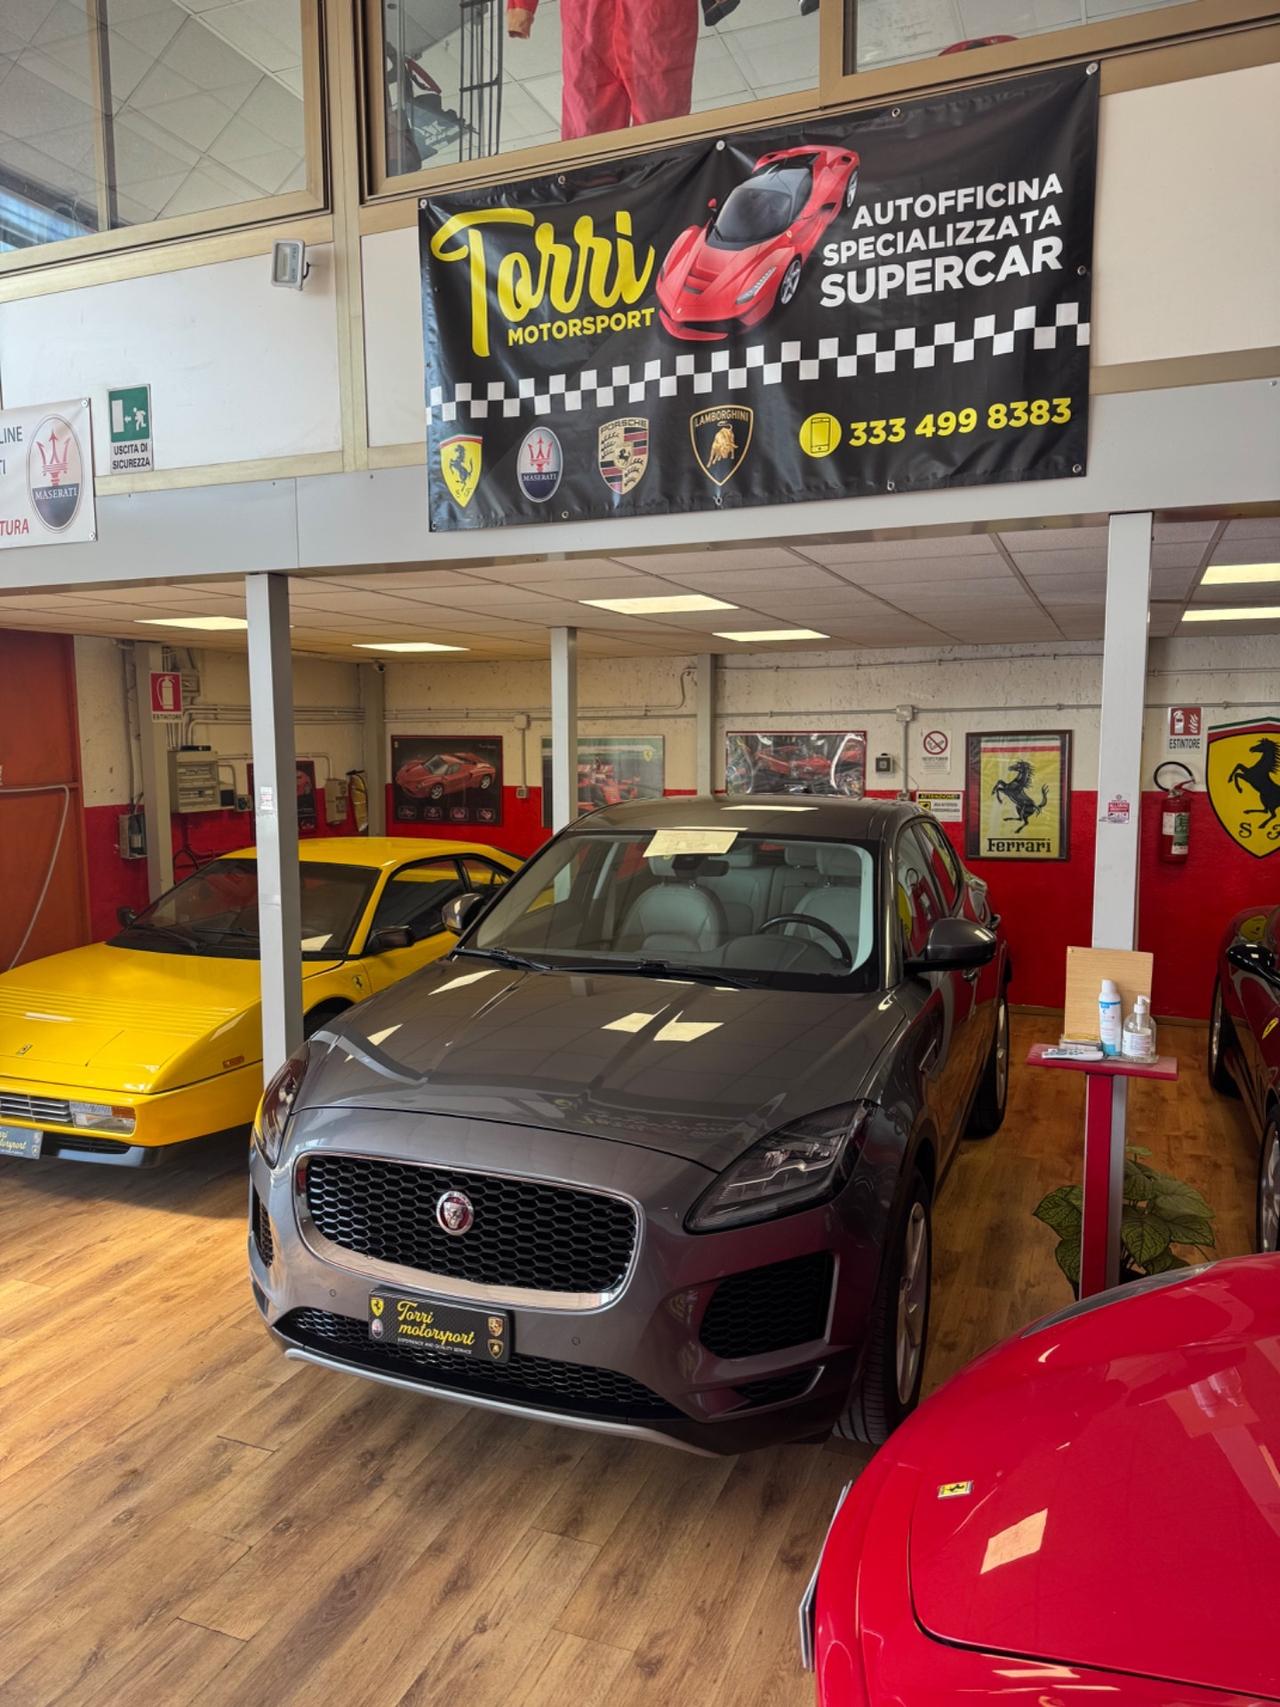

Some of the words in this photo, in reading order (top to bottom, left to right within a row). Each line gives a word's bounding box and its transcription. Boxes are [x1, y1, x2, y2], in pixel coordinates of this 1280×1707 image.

[852, 173, 1063, 230] AUTOFFICINA
[822, 204, 1062, 267] SPECIALIZZATA
[820, 235, 1063, 308] SUPERCAR
[430, 207, 656, 357] Torri
[508, 307, 655, 347] MOTORSPORT
[600, 418, 648, 433] PORSCHE
[694, 409, 750, 427] LAMBORGHINI
[849, 417, 906, 447] 333
[914, 407, 977, 438] 499
[987, 397, 1072, 430] 8383
[113, 445, 139, 456] USCITA
[140, 443, 148, 453] DI
[112, 457, 150, 470] SICUREZZA
[523, 473, 557, 482] MASERATI
[34, 487, 78, 499] MASERATI
[1169, 738, 1201, 750] ESTINTORE
[987, 838, 1052, 853] Ferrari
[397, 1301, 434, 1323] Torri
[398, 1324, 476, 1345] motorsport
